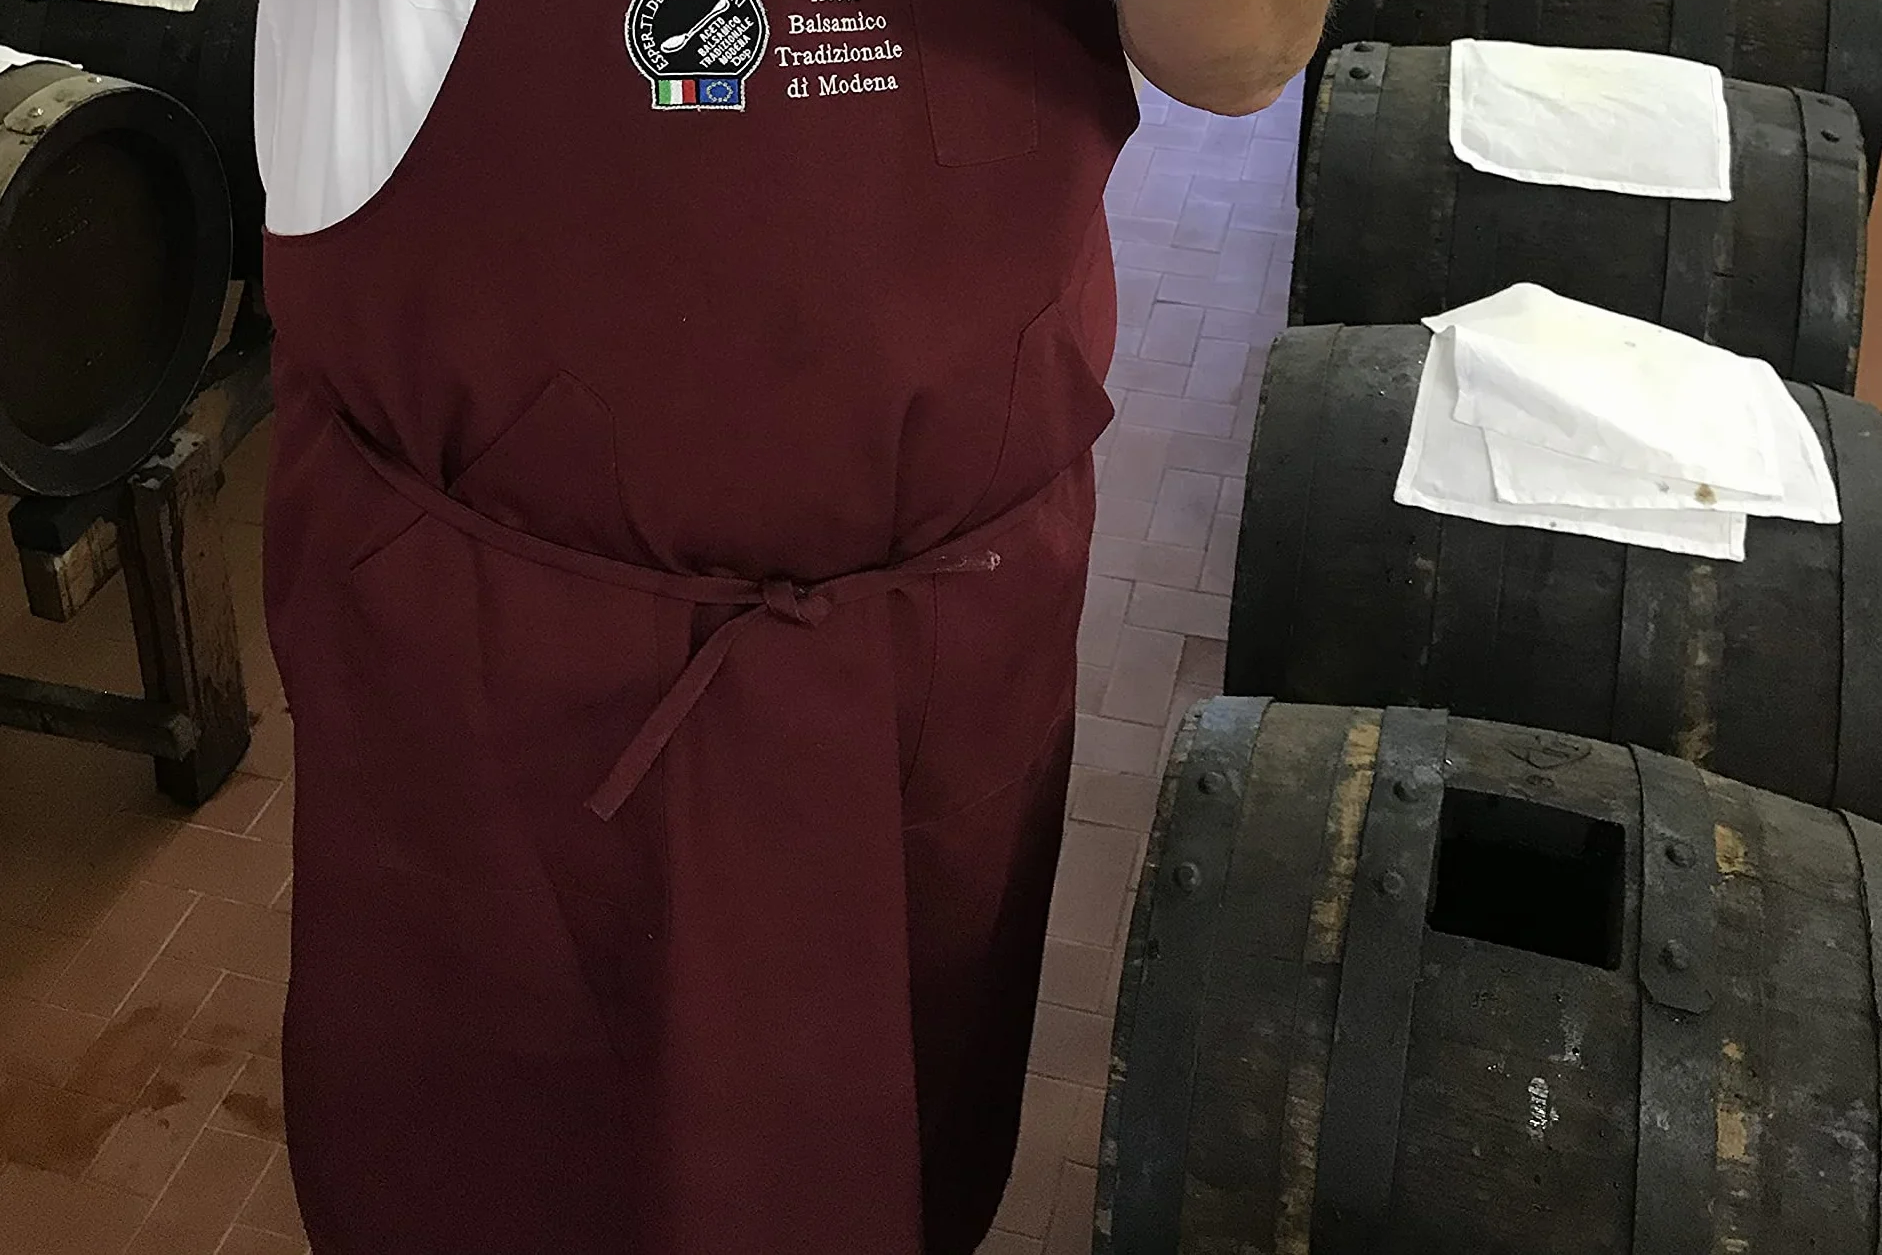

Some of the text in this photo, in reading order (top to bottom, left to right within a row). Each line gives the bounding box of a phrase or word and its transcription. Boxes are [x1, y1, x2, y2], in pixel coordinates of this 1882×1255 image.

[697, 15, 742, 57] BALSAMICO
[699, 16, 726, 43] ACETO
[788, 12, 887, 35] Balsamico
[640, 13, 669, 71] ESPERTI
[699, 16, 755, 68] TRADIZIONALE
[718, 34, 751, 66] MODENA
[775, 40, 903, 67] Tradizionale
[787, 74, 899, 98] di Modena
